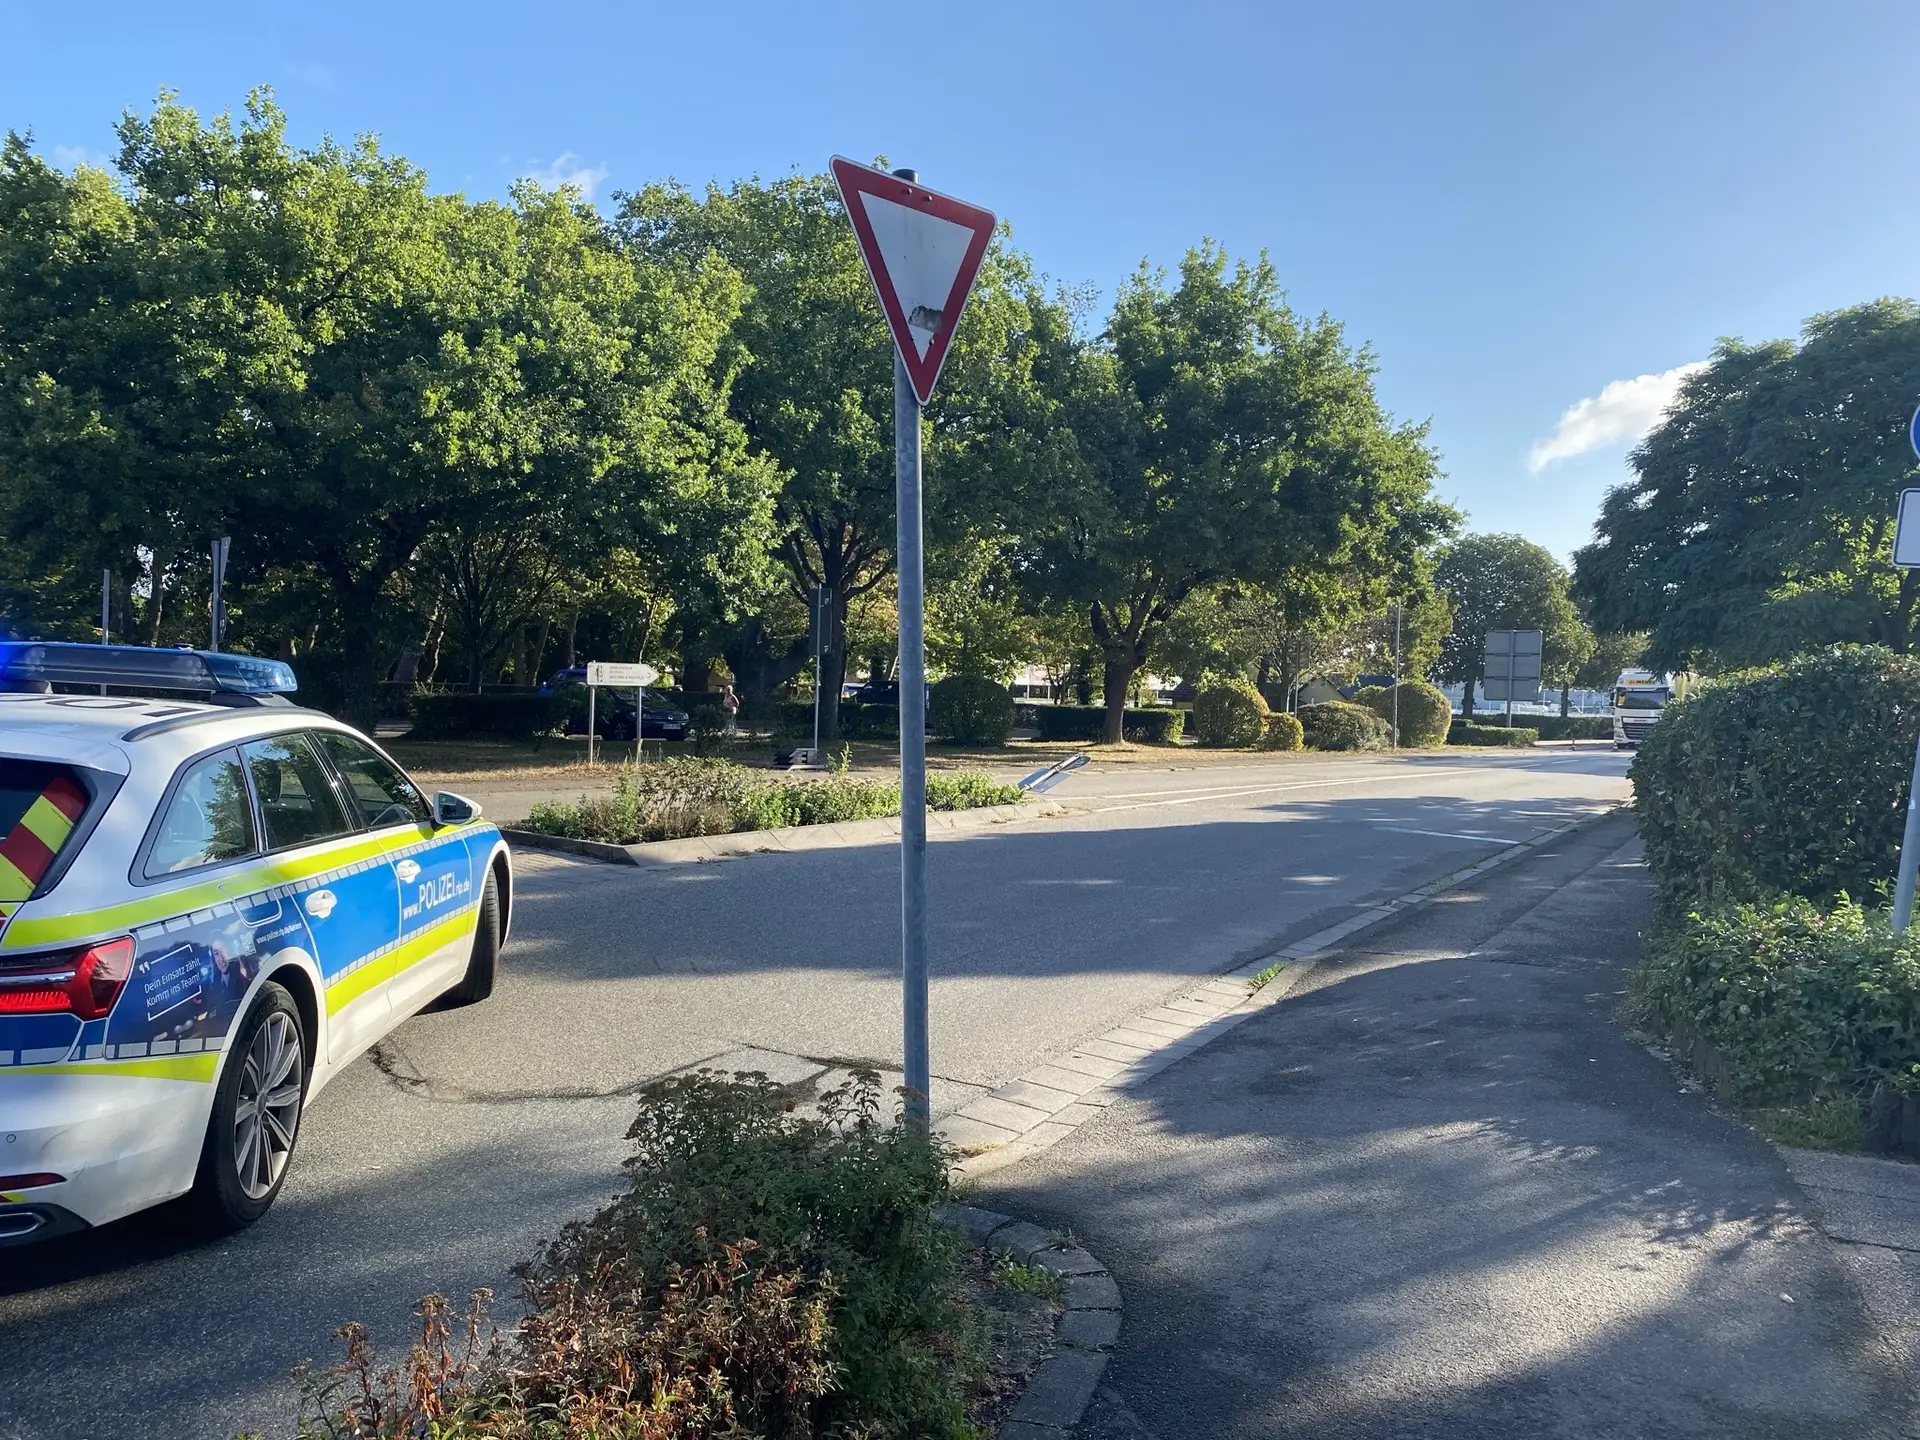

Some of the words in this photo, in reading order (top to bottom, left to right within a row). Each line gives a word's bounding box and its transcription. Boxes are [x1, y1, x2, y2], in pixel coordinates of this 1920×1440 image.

[144, 979, 161, 994] Dein
[162, 966, 185, 985] Einsatz
[146, 989, 170, 1007] Komm
[170, 984, 181, 994] ins
[181, 972, 200, 989] Team!
